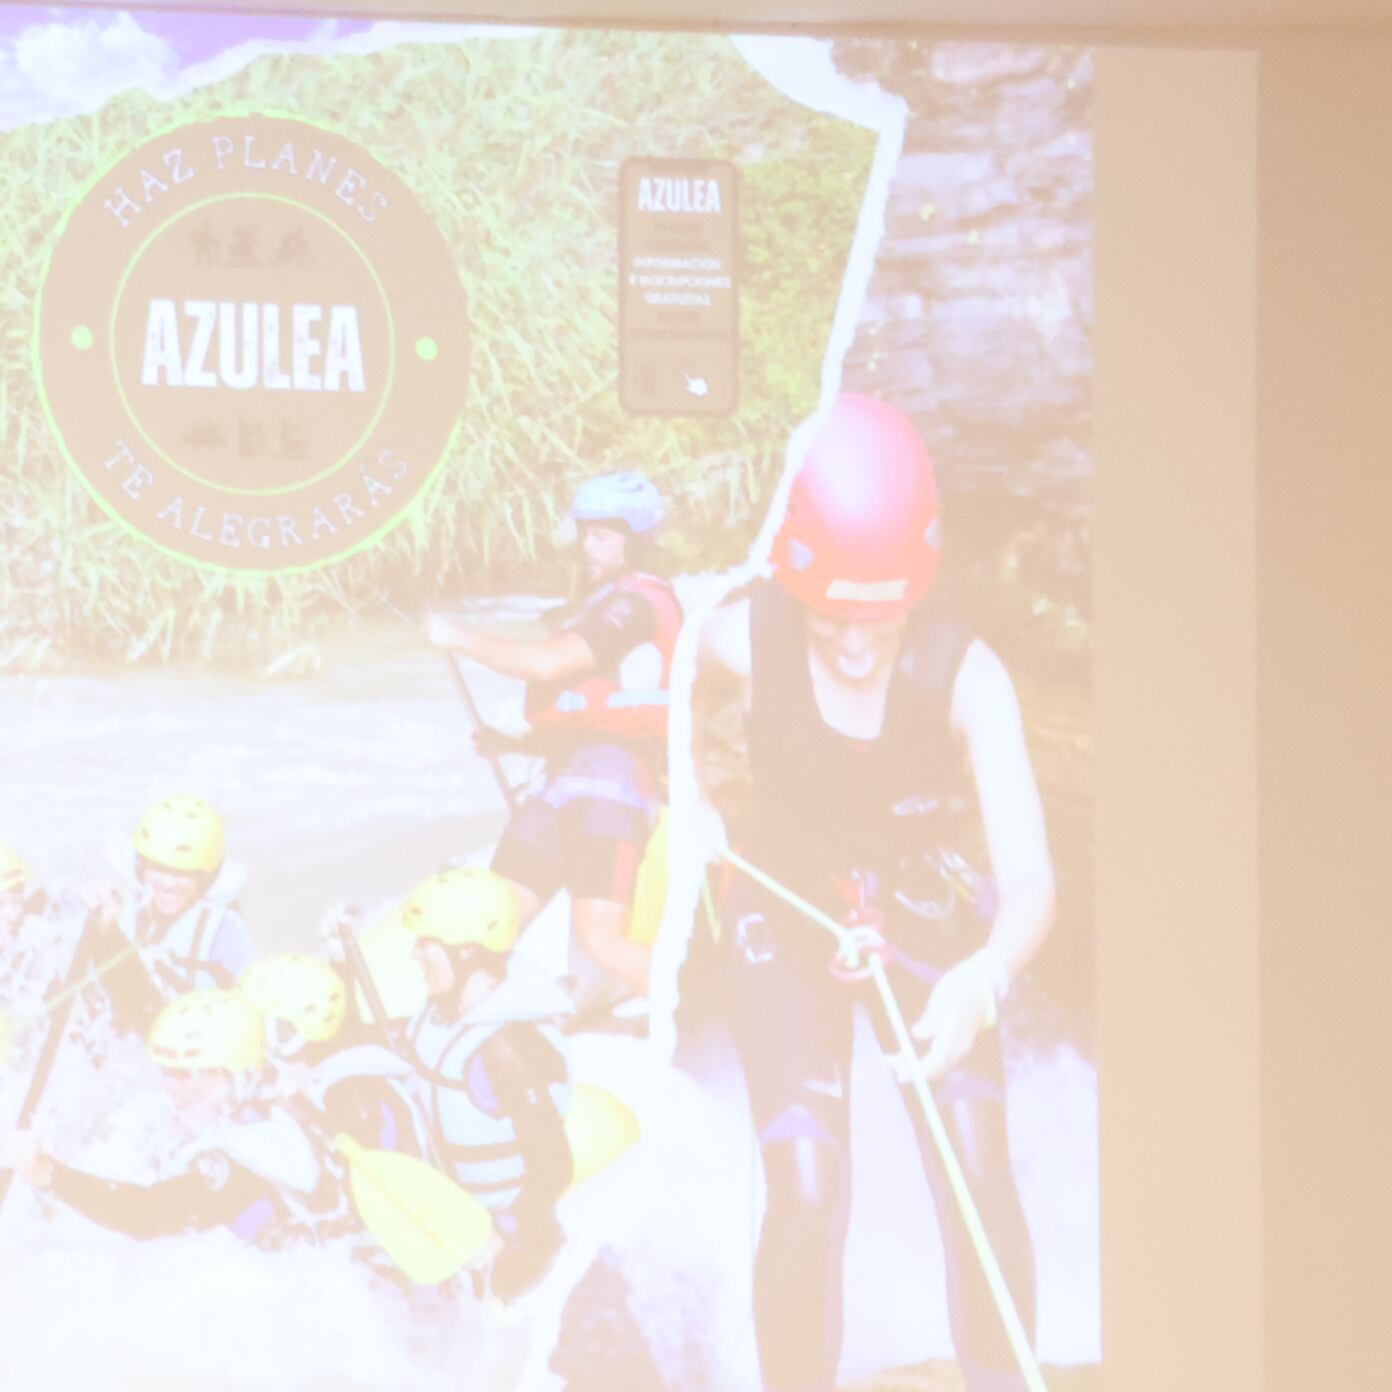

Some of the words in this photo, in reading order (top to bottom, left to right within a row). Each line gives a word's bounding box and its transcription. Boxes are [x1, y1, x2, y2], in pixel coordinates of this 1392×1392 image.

[103, 148, 195, 227] HAZ
[212, 135, 388, 224] PLANES
[637, 177, 722, 213] AZULEA
[141, 299, 366, 392] AZULEA
[103, 440, 154, 499] TE
[157, 449, 408, 549] ALEGRARÁS
